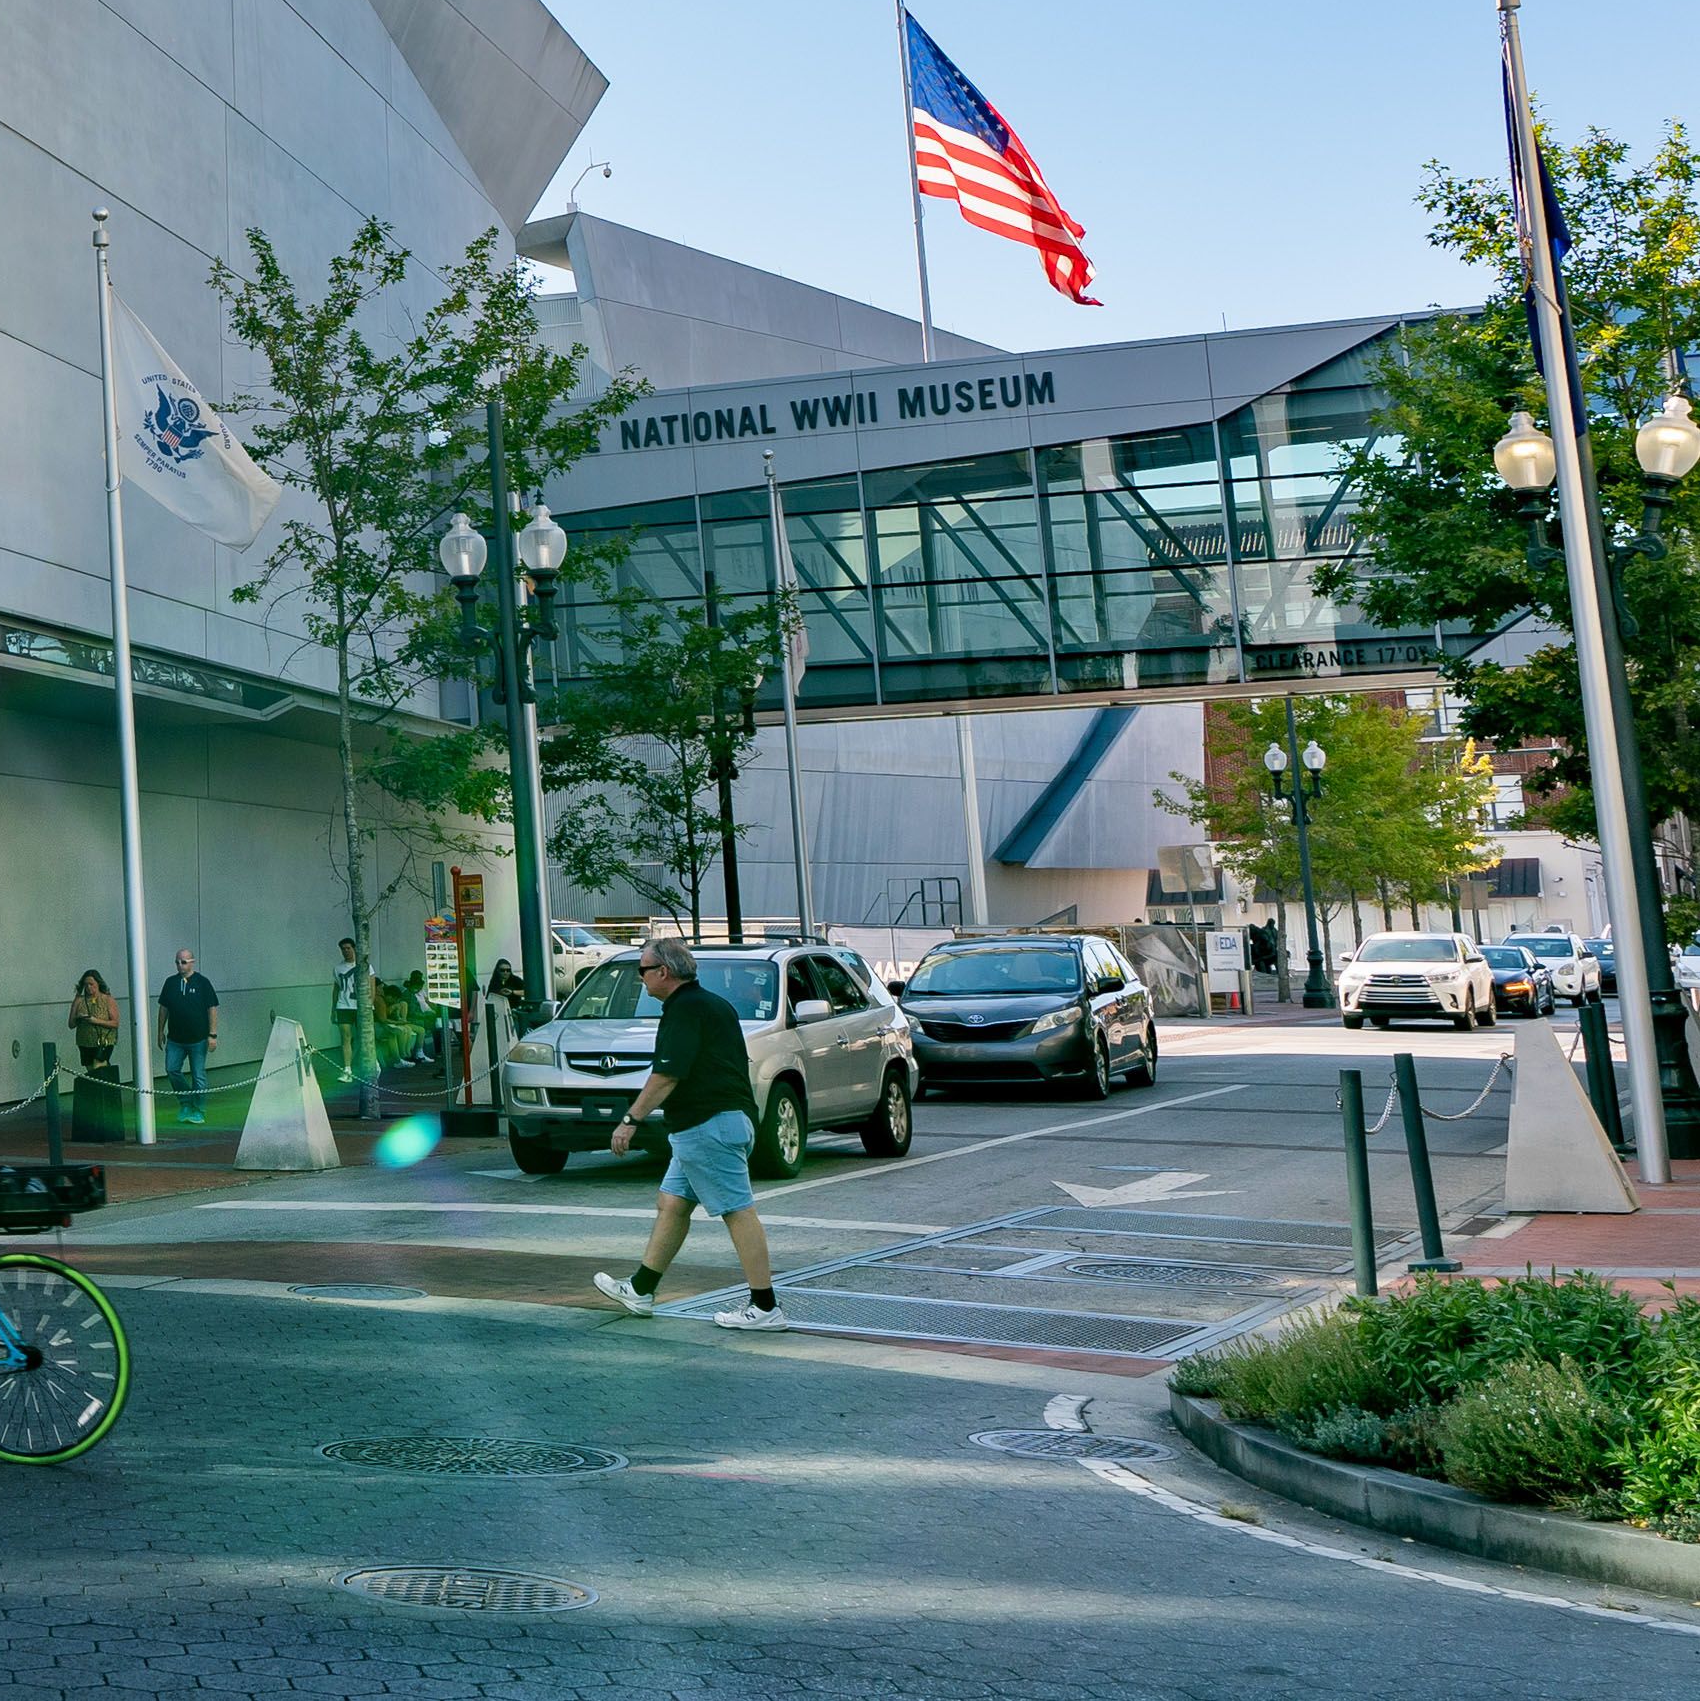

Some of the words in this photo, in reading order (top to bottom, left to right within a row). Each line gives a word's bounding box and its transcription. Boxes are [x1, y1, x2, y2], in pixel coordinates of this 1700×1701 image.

[141, 373, 168, 385] UNITED
[619, 404, 777, 450] NATIONAL
[789, 390, 878, 431] WWII
[897, 371, 1056, 420] MUSEUM
[134, 433, 157, 459] SEMPER
[156, 456, 187, 479] PARATUS
[145, 457, 163, 473] 1790
[1255, 649, 1367, 670] CLEARANCE
[1219, 936, 1237, 950] EDA
